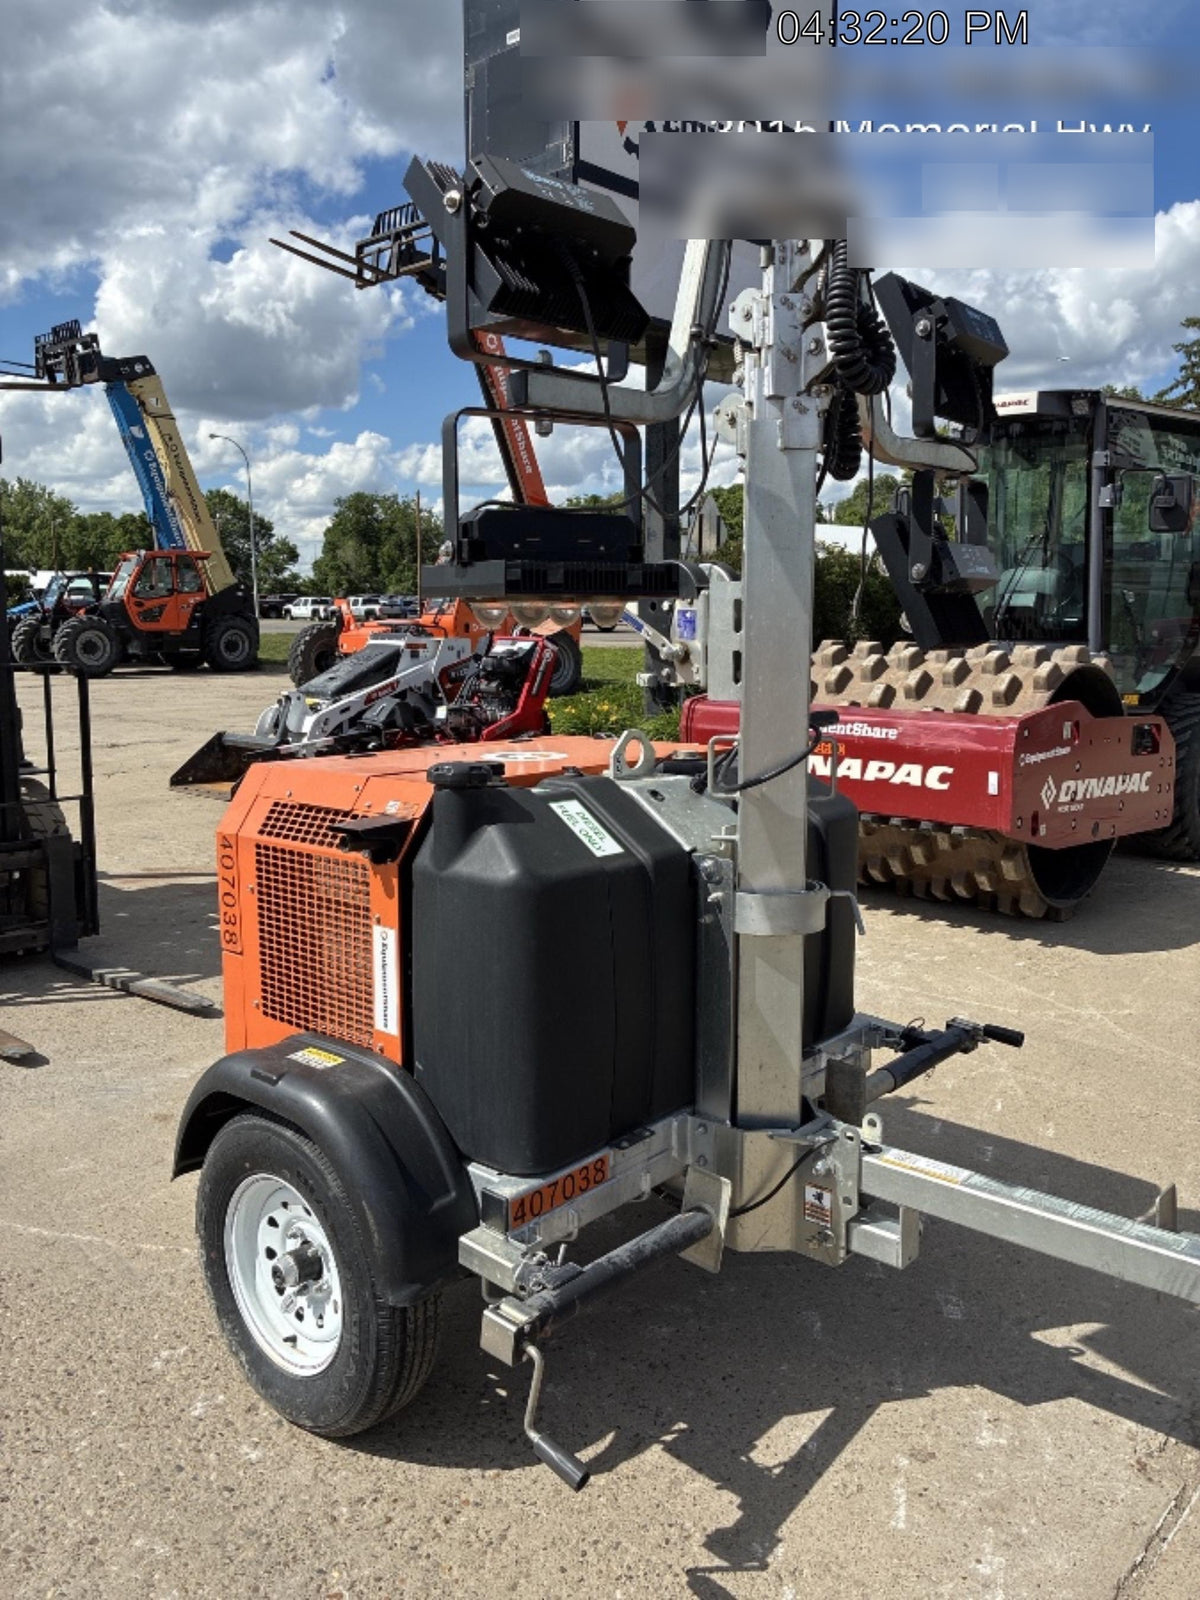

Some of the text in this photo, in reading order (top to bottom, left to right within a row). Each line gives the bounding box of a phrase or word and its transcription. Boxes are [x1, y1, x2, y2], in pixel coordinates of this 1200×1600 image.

[807, 754, 954, 790] NAPAC
[1058, 771, 1153, 802] DYNAPAC
[556, 804, 606, 852] FUEL ONLY
[575, 811, 607, 842] DIESEL
[220, 834, 238, 945] 407038
[513, 1158, 605, 1223] 407038
